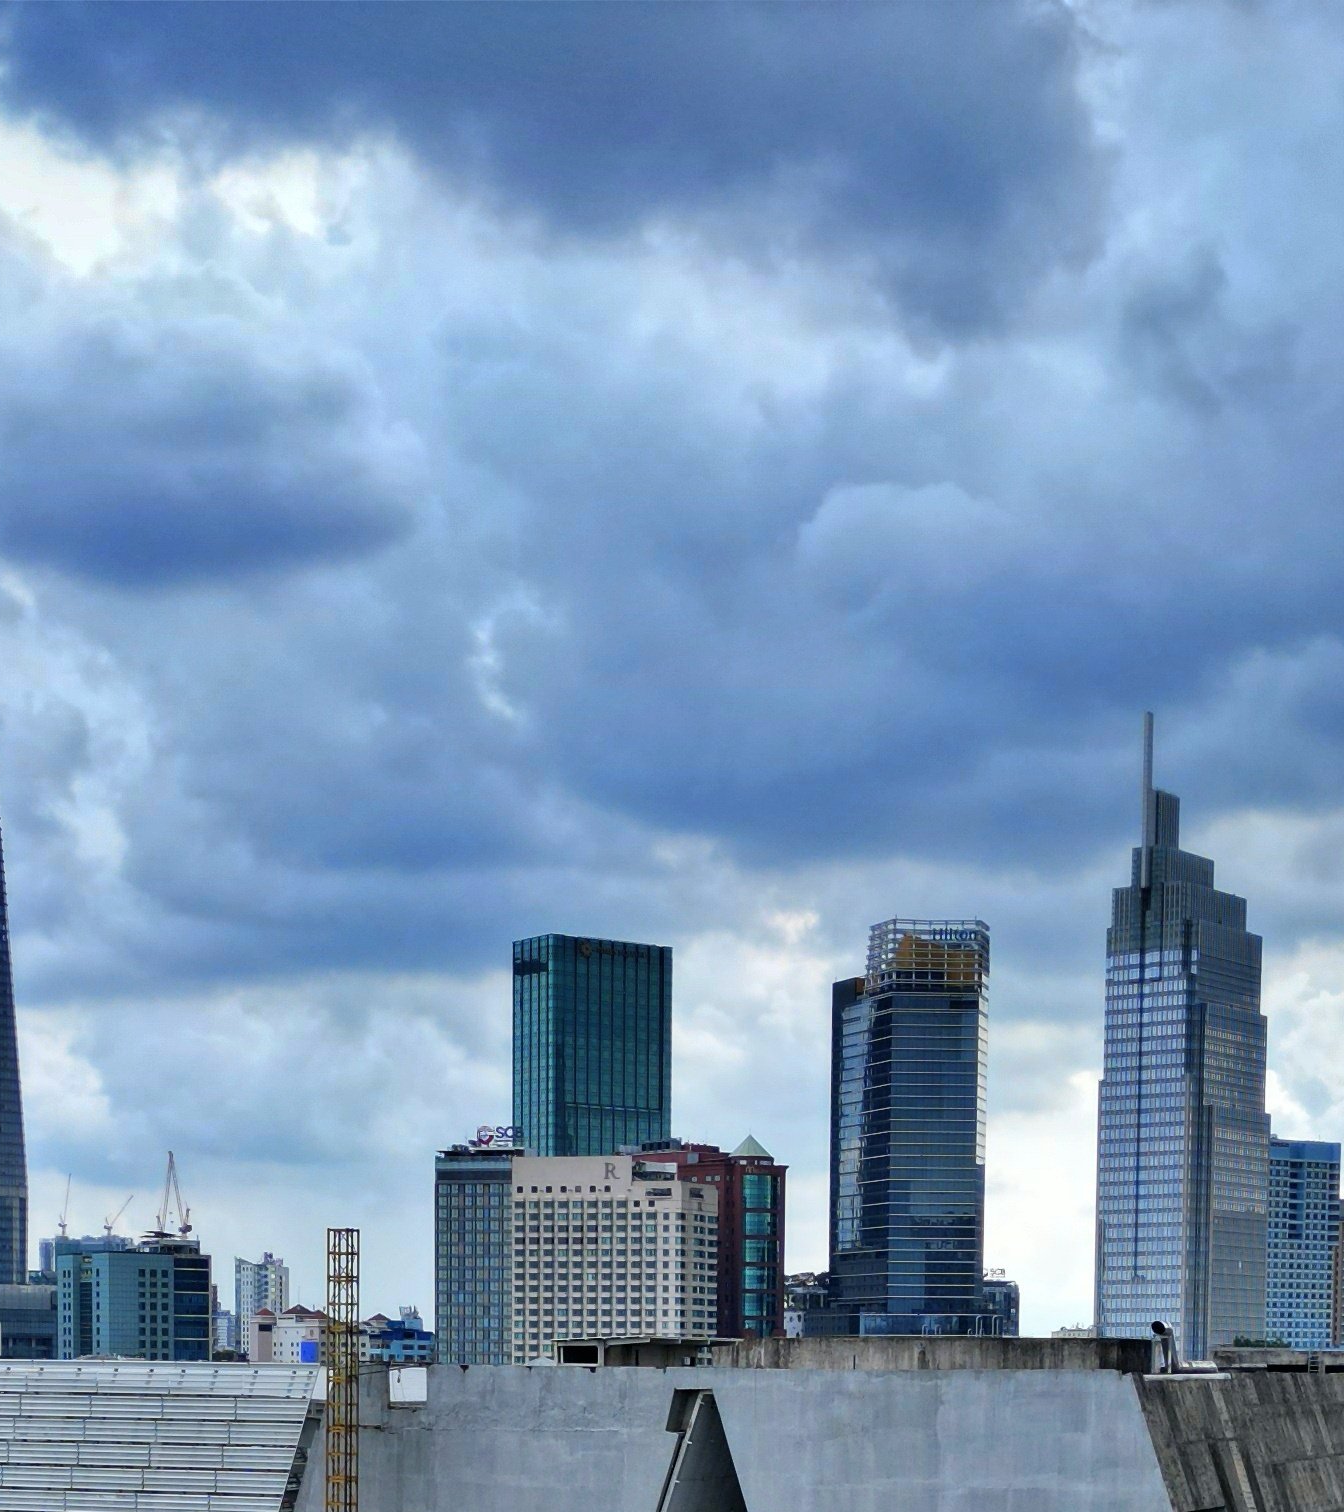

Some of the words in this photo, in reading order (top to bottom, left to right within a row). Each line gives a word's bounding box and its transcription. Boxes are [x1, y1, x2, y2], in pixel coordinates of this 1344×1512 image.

[933, 927, 976, 940] Hilton
[496, 1126, 523, 1138] SCB
[604, 1162, 620, 1179] R
